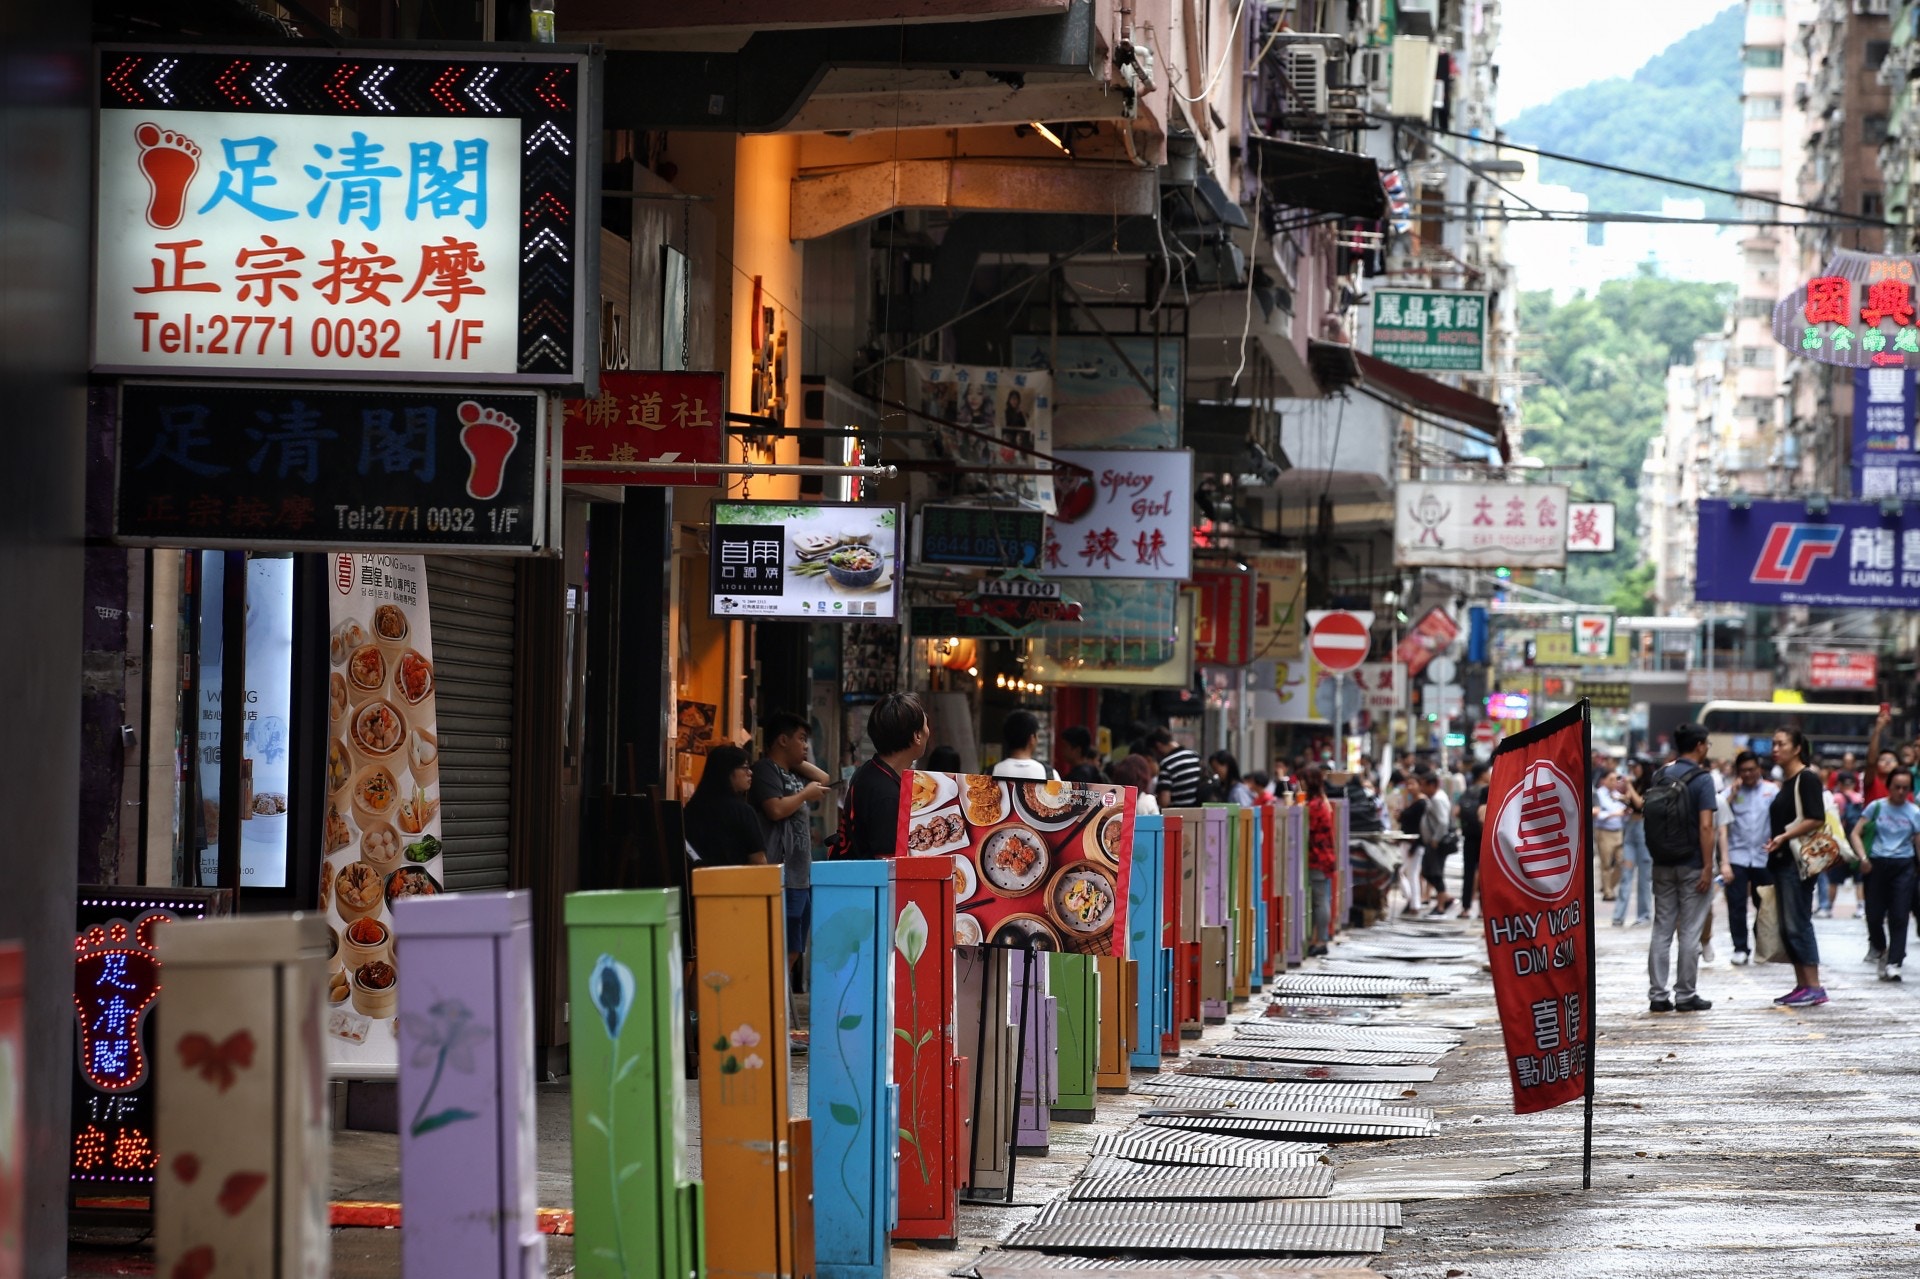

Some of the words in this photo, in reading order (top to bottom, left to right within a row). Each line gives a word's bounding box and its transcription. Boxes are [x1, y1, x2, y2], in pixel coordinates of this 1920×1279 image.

[198, 132, 489, 232] 足清閣
[133, 235, 487, 313] 正宗按摩
[1870, 260, 1913, 279] PHO
[1376, 294, 1481, 328] 麗晶賓館
[135, 313, 294, 357] Tel:2771
[311, 318, 401, 359] 0032
[428, 321, 484, 361] 1/F
[1438, 331, 1479, 344] HOTEL
[136, 399, 438, 484] 足清閣
[1100, 469, 1154, 504] Spicy
[137, 494, 317, 532] 正宗按摩
[334, 504, 419, 531] Tel:2771
[426, 507, 475, 533] 0032
[489, 508, 519, 534] 1/F
[1131, 490, 1172, 522] Girl
[1473, 533, 1493, 545] EAT
[1570, 508, 1601, 546] 萬
[984, 581, 1055, 597] TATTOO
[1849, 570, 1894, 586] LUNG
[207, 690, 257, 703] WG
[1491, 912, 1541, 944] HAY
[1514, 946, 1548, 976] DIM
[93, 953, 137, 1077] 足清閣
[1515, 1042, 1586, 1088] 點心專門店
[87, 1096, 138, 1121] 1/F
